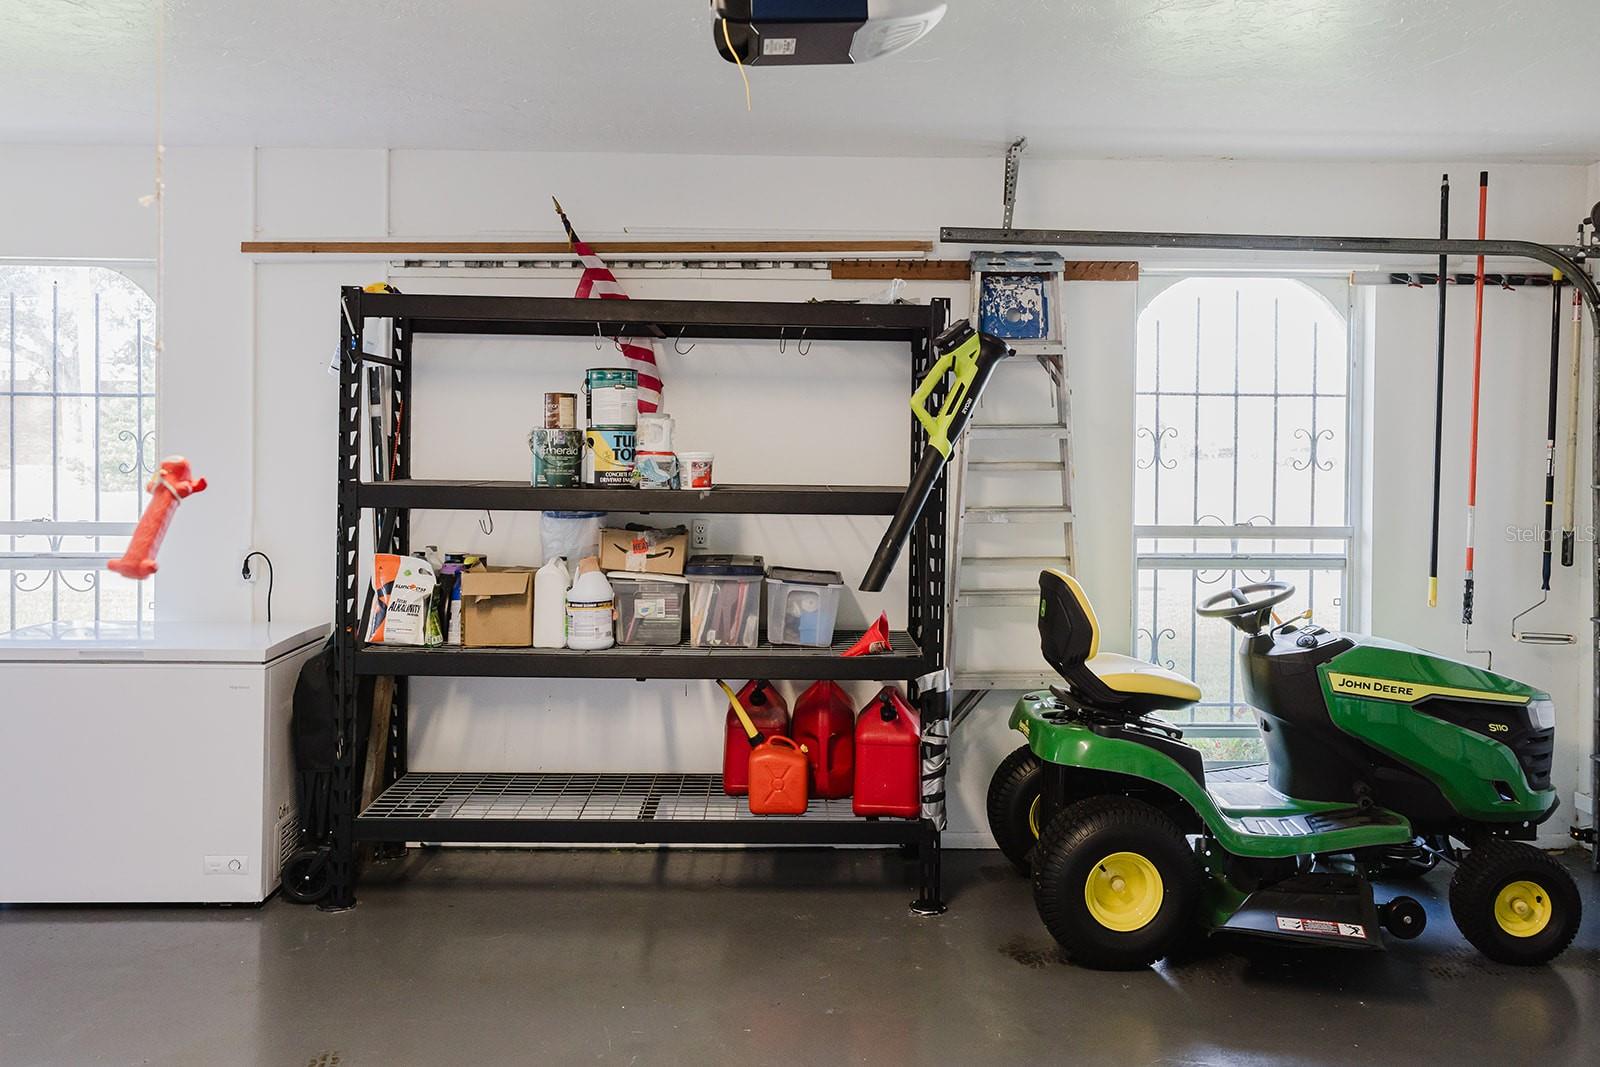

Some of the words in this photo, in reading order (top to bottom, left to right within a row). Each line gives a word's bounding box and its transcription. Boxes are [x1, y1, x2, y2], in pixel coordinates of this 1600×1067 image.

[543, 443, 579, 455] Emerald
[1338, 677, 1371, 690] JOHN
[1373, 682, 1414, 696] DEERE
[1488, 723, 1509, 733] S110
